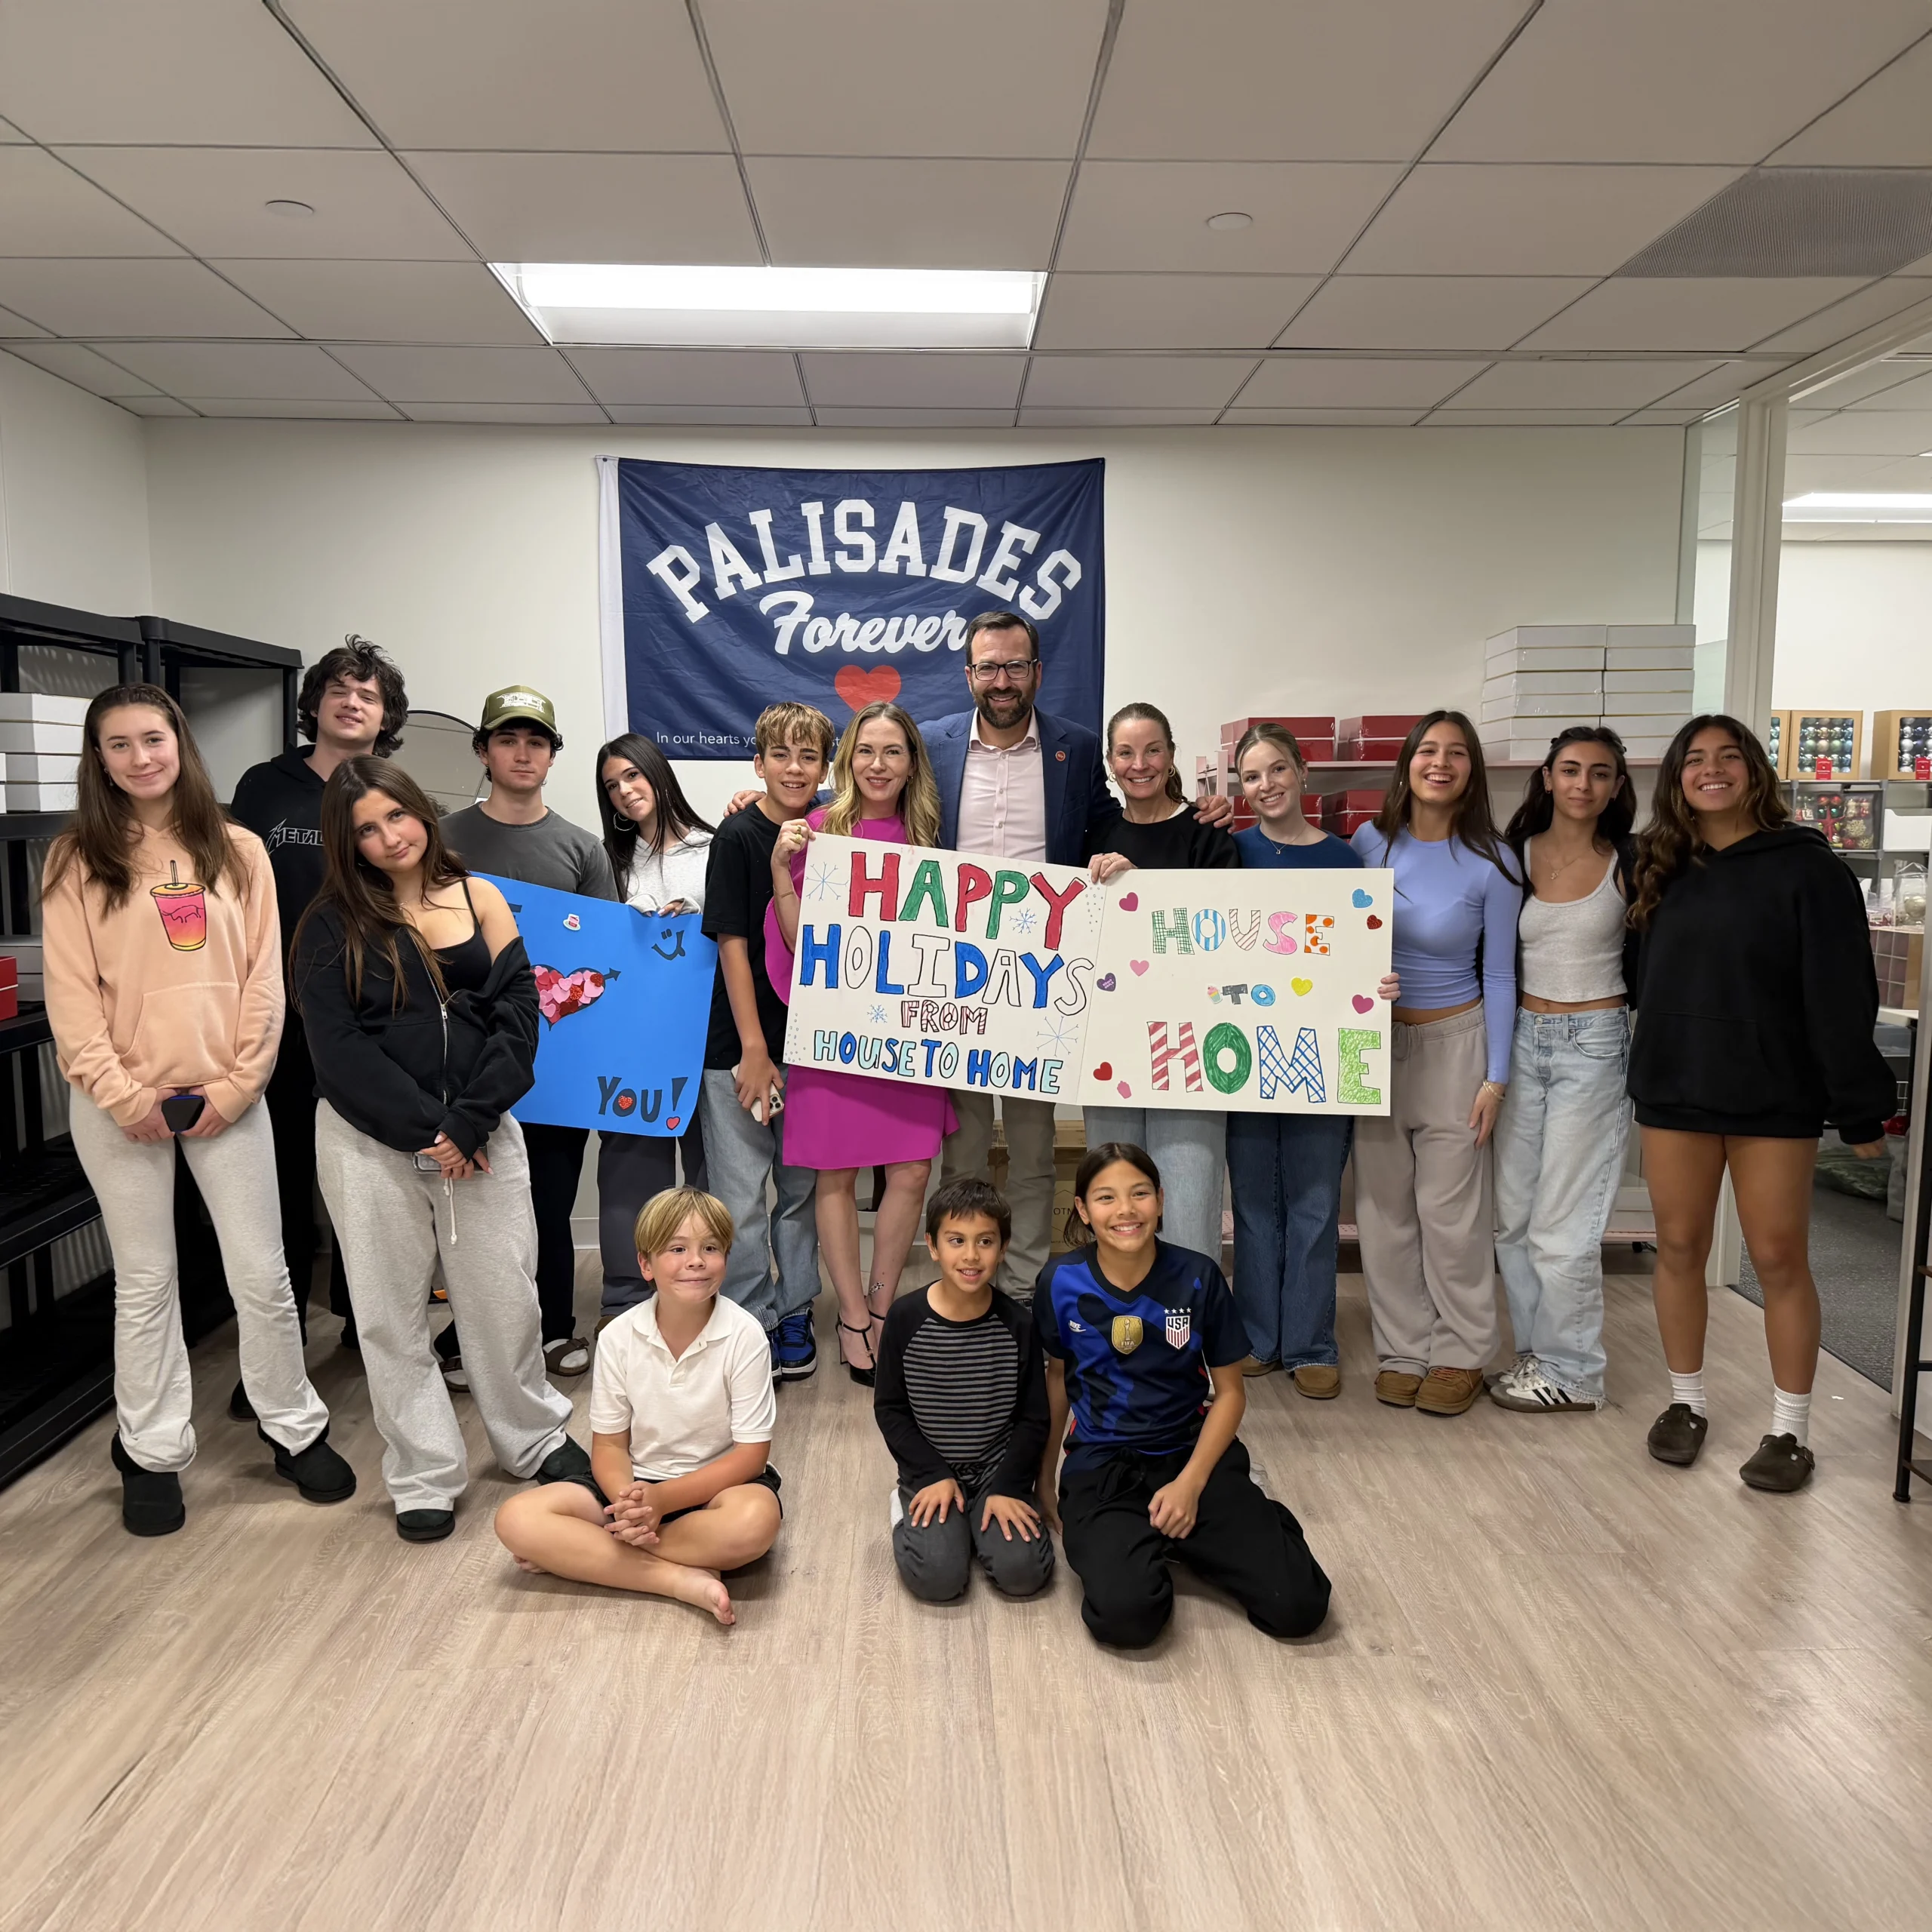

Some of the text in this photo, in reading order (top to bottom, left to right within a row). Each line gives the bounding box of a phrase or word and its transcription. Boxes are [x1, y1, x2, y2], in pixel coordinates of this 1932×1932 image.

[645, 499, 1081, 623] PALISADES
[759, 590, 967, 654] Forever
[657, 731, 756, 748] In our hearts yo
[266, 818, 325, 854] METAL
[848, 851, 1087, 950] HAPPY
[1151, 907, 1335, 956] HOUSE
[798, 924, 1094, 1016] HOLIDAYS
[901, 1000, 988, 1035] FROM
[1222, 984, 1275, 1007] TO
[814, 1030, 1063, 1094] HOUSE TO HOME
[1146, 1021, 1381, 1105] HOME
[597, 1075, 688, 1123] YOU!
[1168, 1317, 1189, 1330] USA
